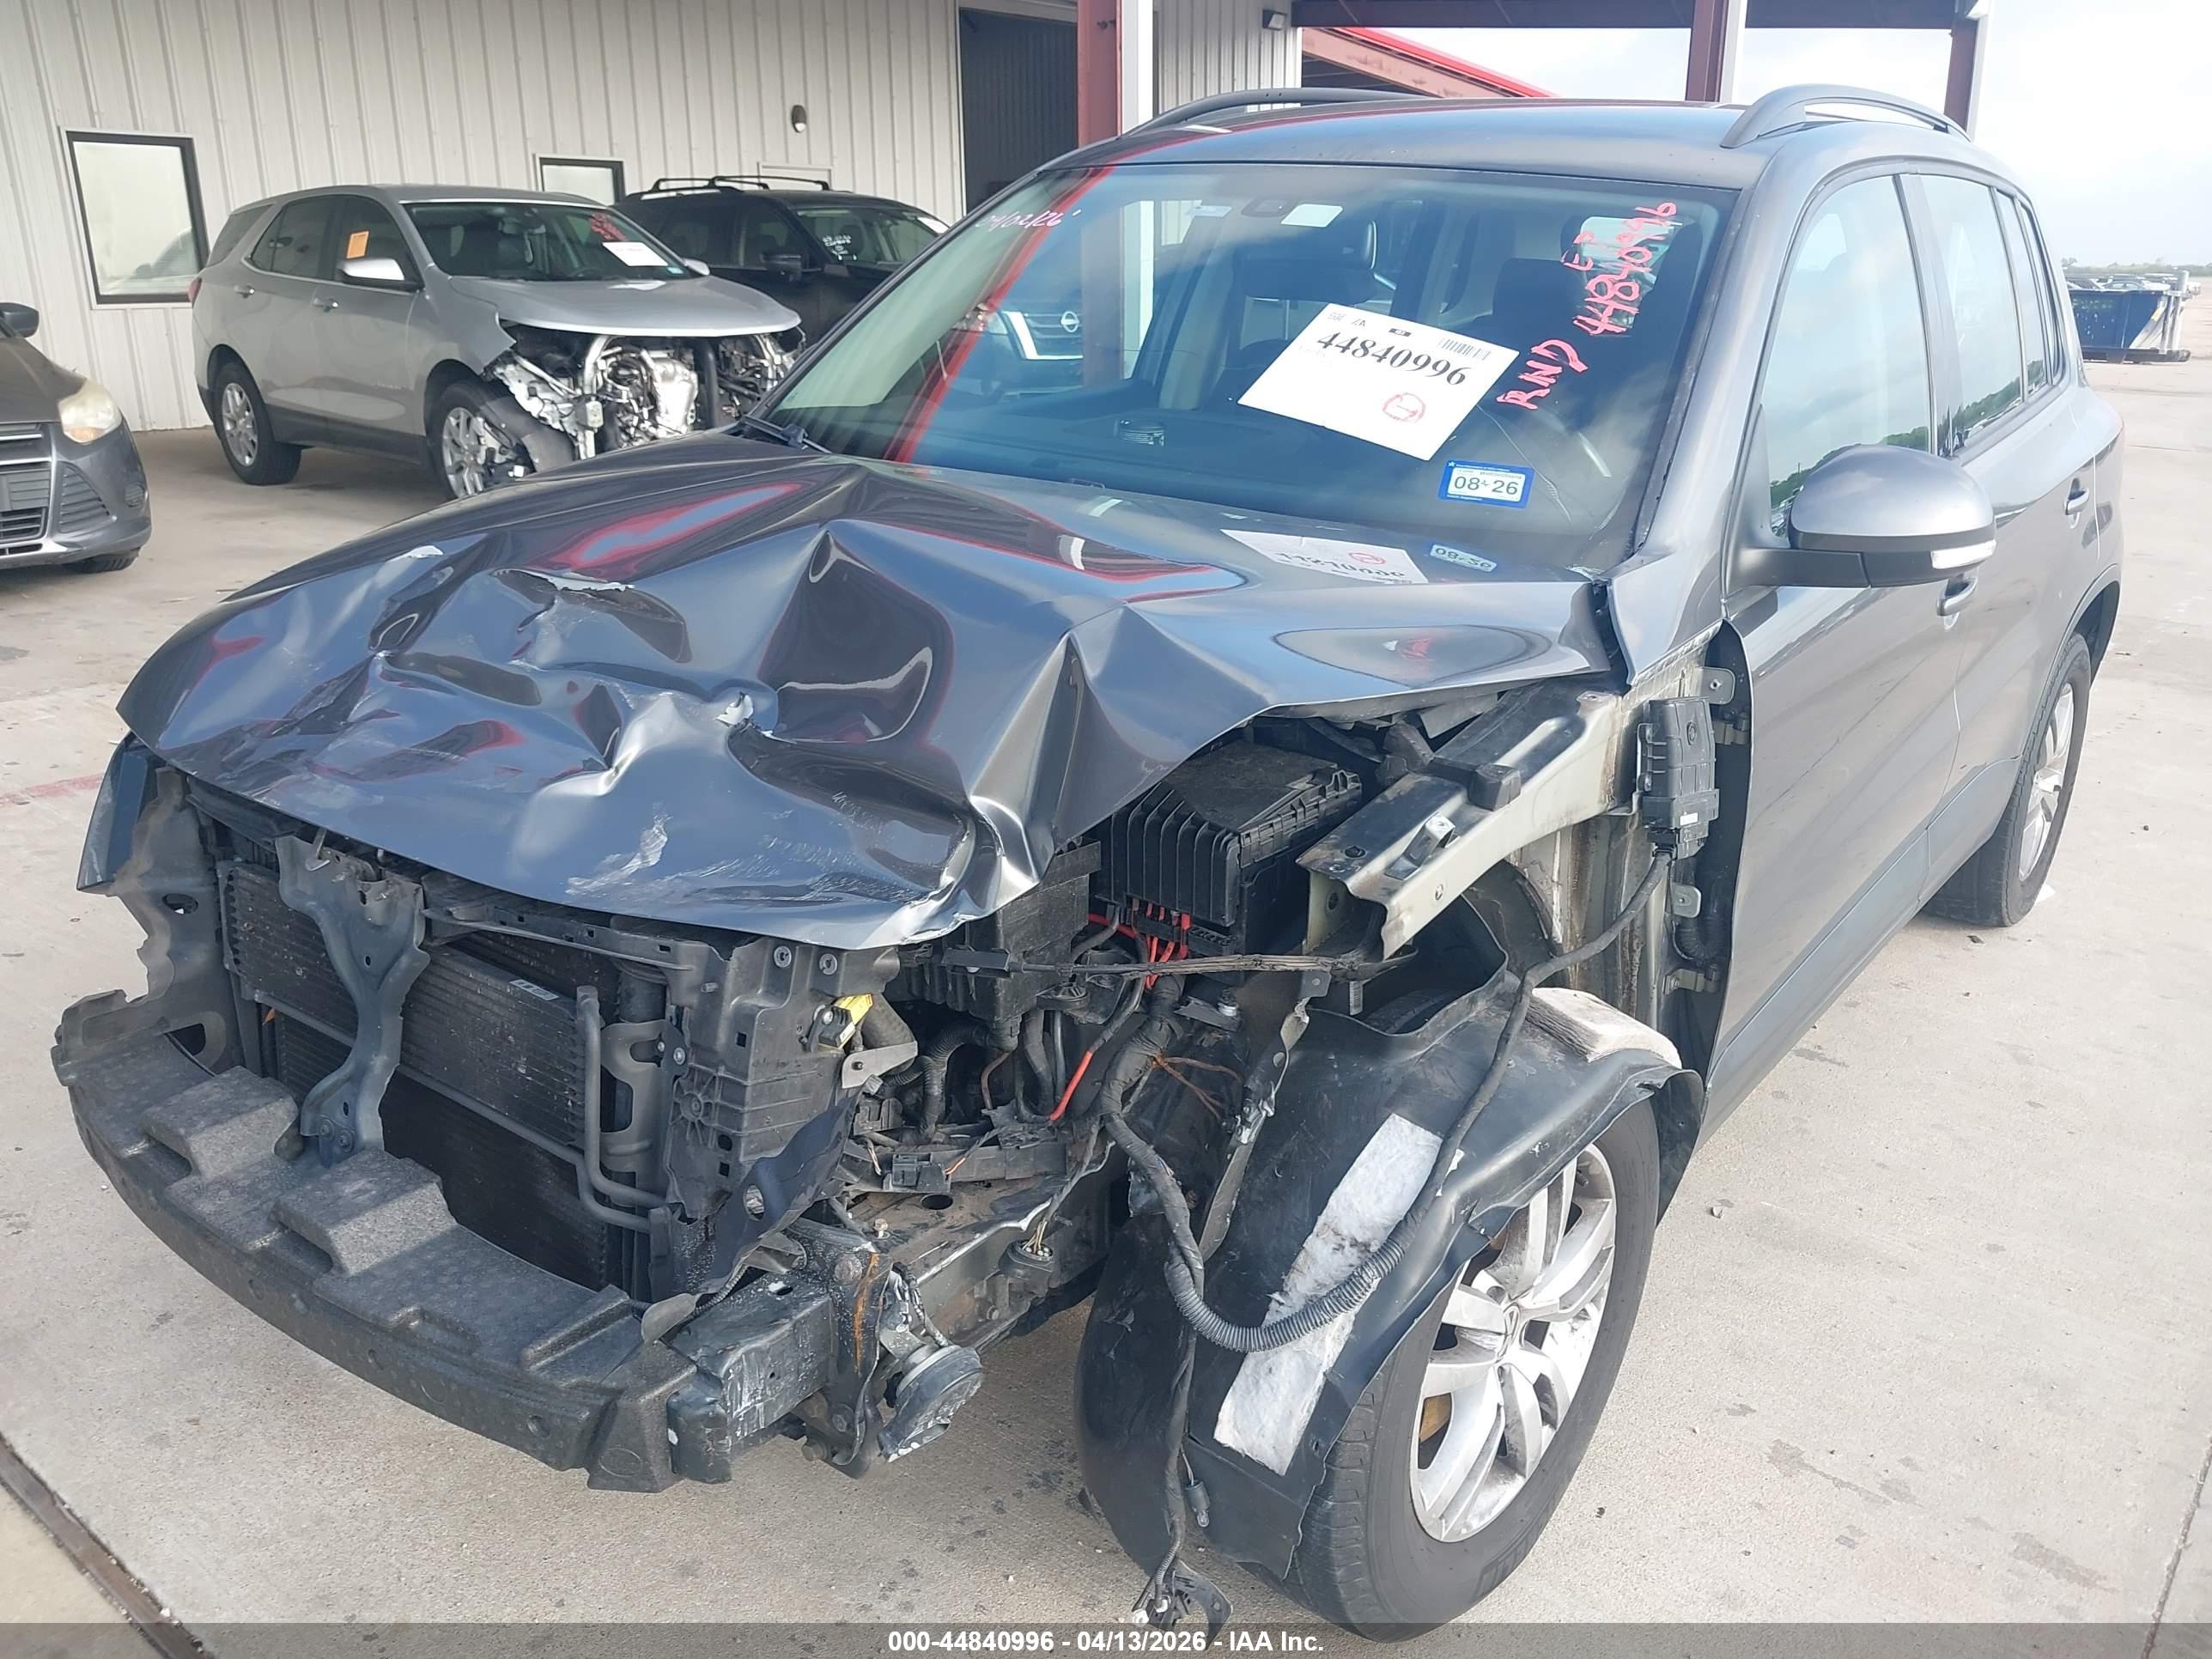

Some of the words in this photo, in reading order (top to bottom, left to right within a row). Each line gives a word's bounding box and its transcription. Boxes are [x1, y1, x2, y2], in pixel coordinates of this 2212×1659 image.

[1317, 331, 1472, 386] 44840996
[1497, 339, 1589, 410] RND
[1454, 476, 1480, 491] 08
[1492, 480, 1519, 495] 26
